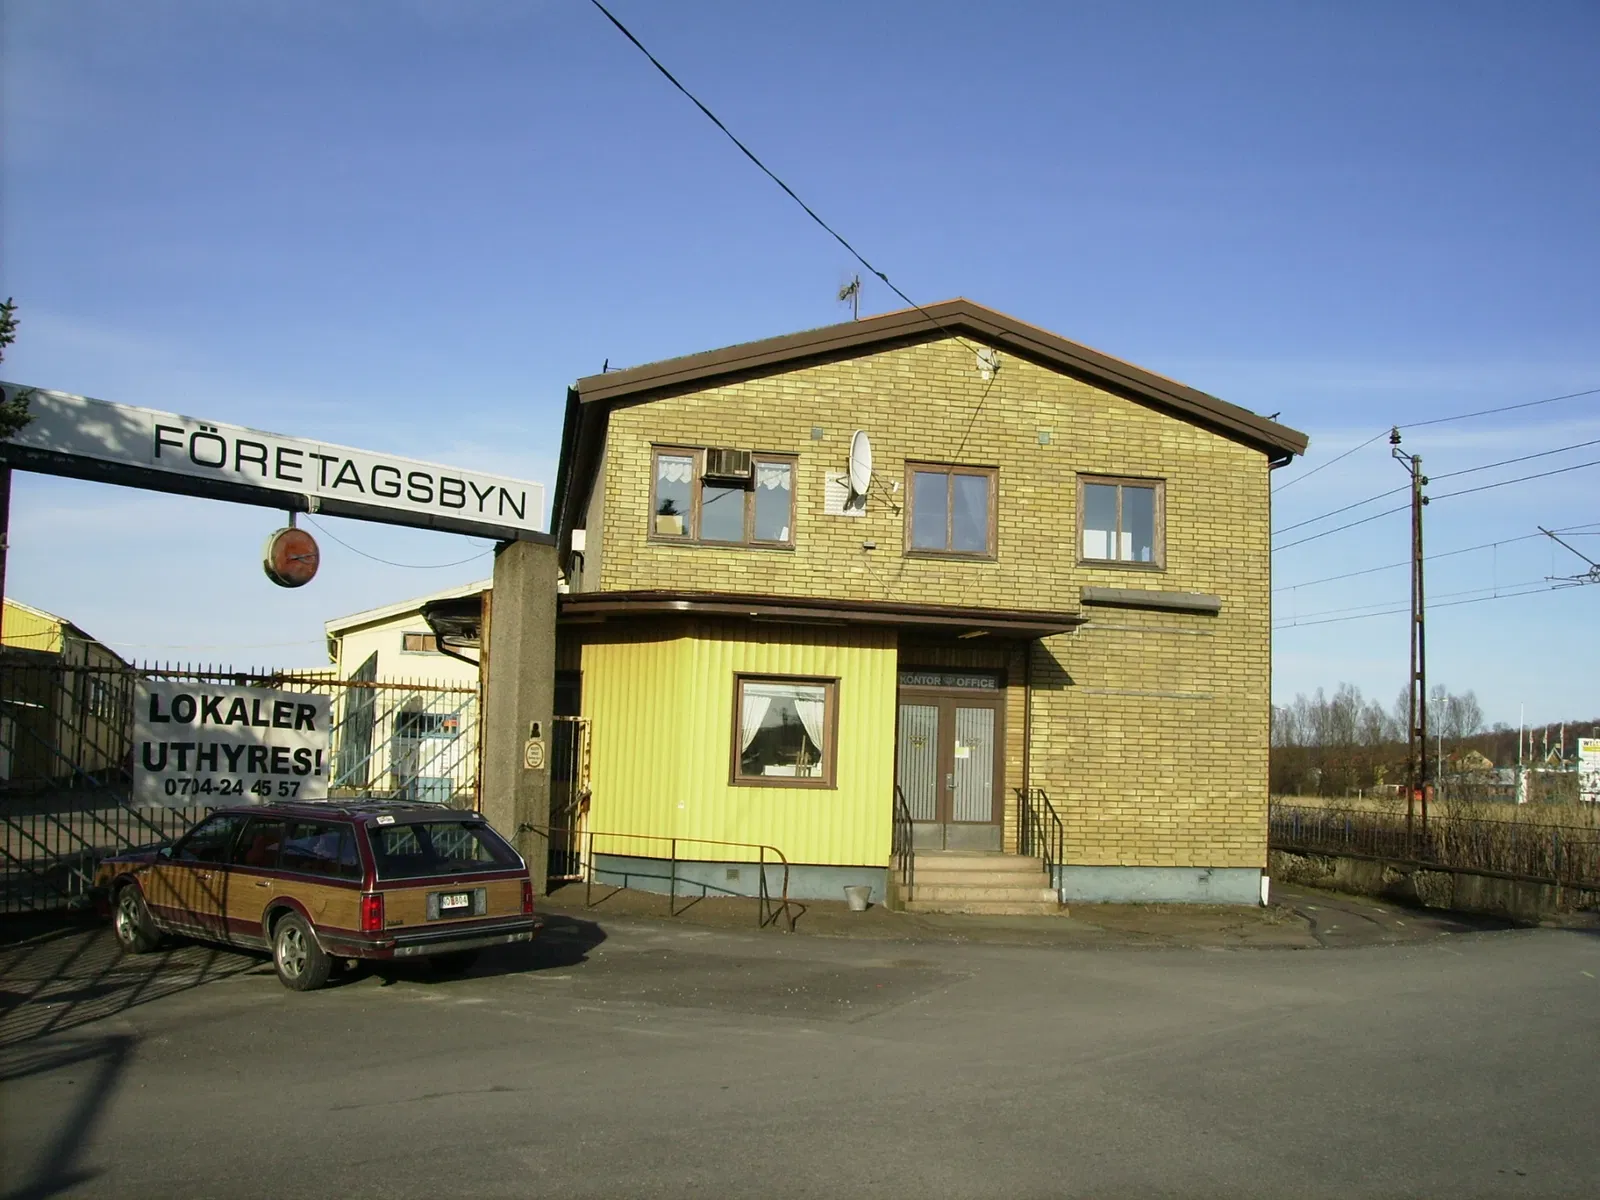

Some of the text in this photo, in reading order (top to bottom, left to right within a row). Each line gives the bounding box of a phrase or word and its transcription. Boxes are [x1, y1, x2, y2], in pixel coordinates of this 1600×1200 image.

[154, 424, 526, 520] FÖRETAGSBYN
[901, 675, 995, 689] KONTOR OFFICE
[149, 693, 317, 731] LOKALER
[142, 742, 323, 776] UTHYRES!
[165, 778, 300, 797] 0704-24 45 57
